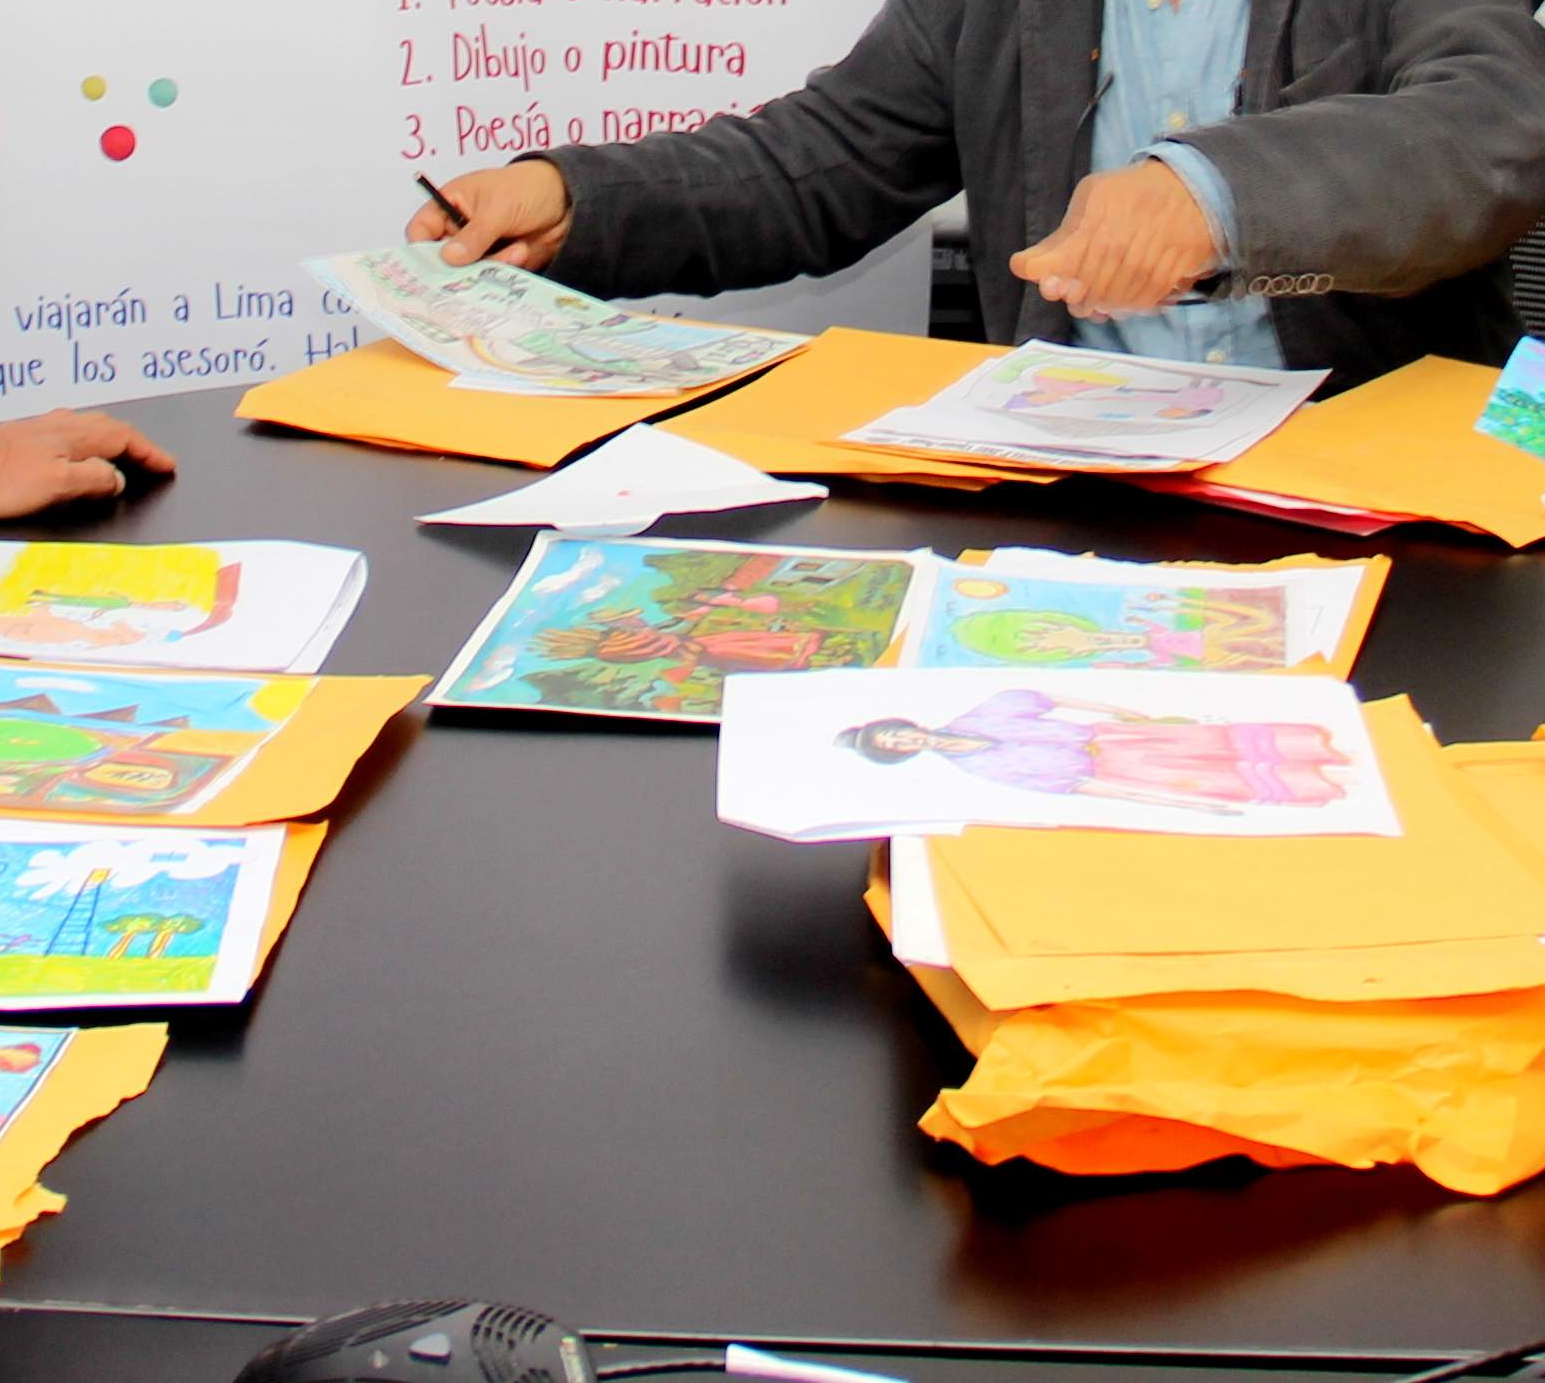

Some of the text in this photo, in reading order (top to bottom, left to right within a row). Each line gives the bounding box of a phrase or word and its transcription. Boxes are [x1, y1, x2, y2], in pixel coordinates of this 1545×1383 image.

[401, 25, 745, 91] 2. Dibujo o pintura
[403, 115, 437, 160] 3.
[456, 101, 550, 155] Poesía
[568, 118, 582, 144] o
[15, 289, 145, 340] viajarán
[175, 296, 189, 322] a
[216, 283, 293, 319] Lima
[74, 342, 115, 384] los
[143, 339, 282, 385] asesoró.
